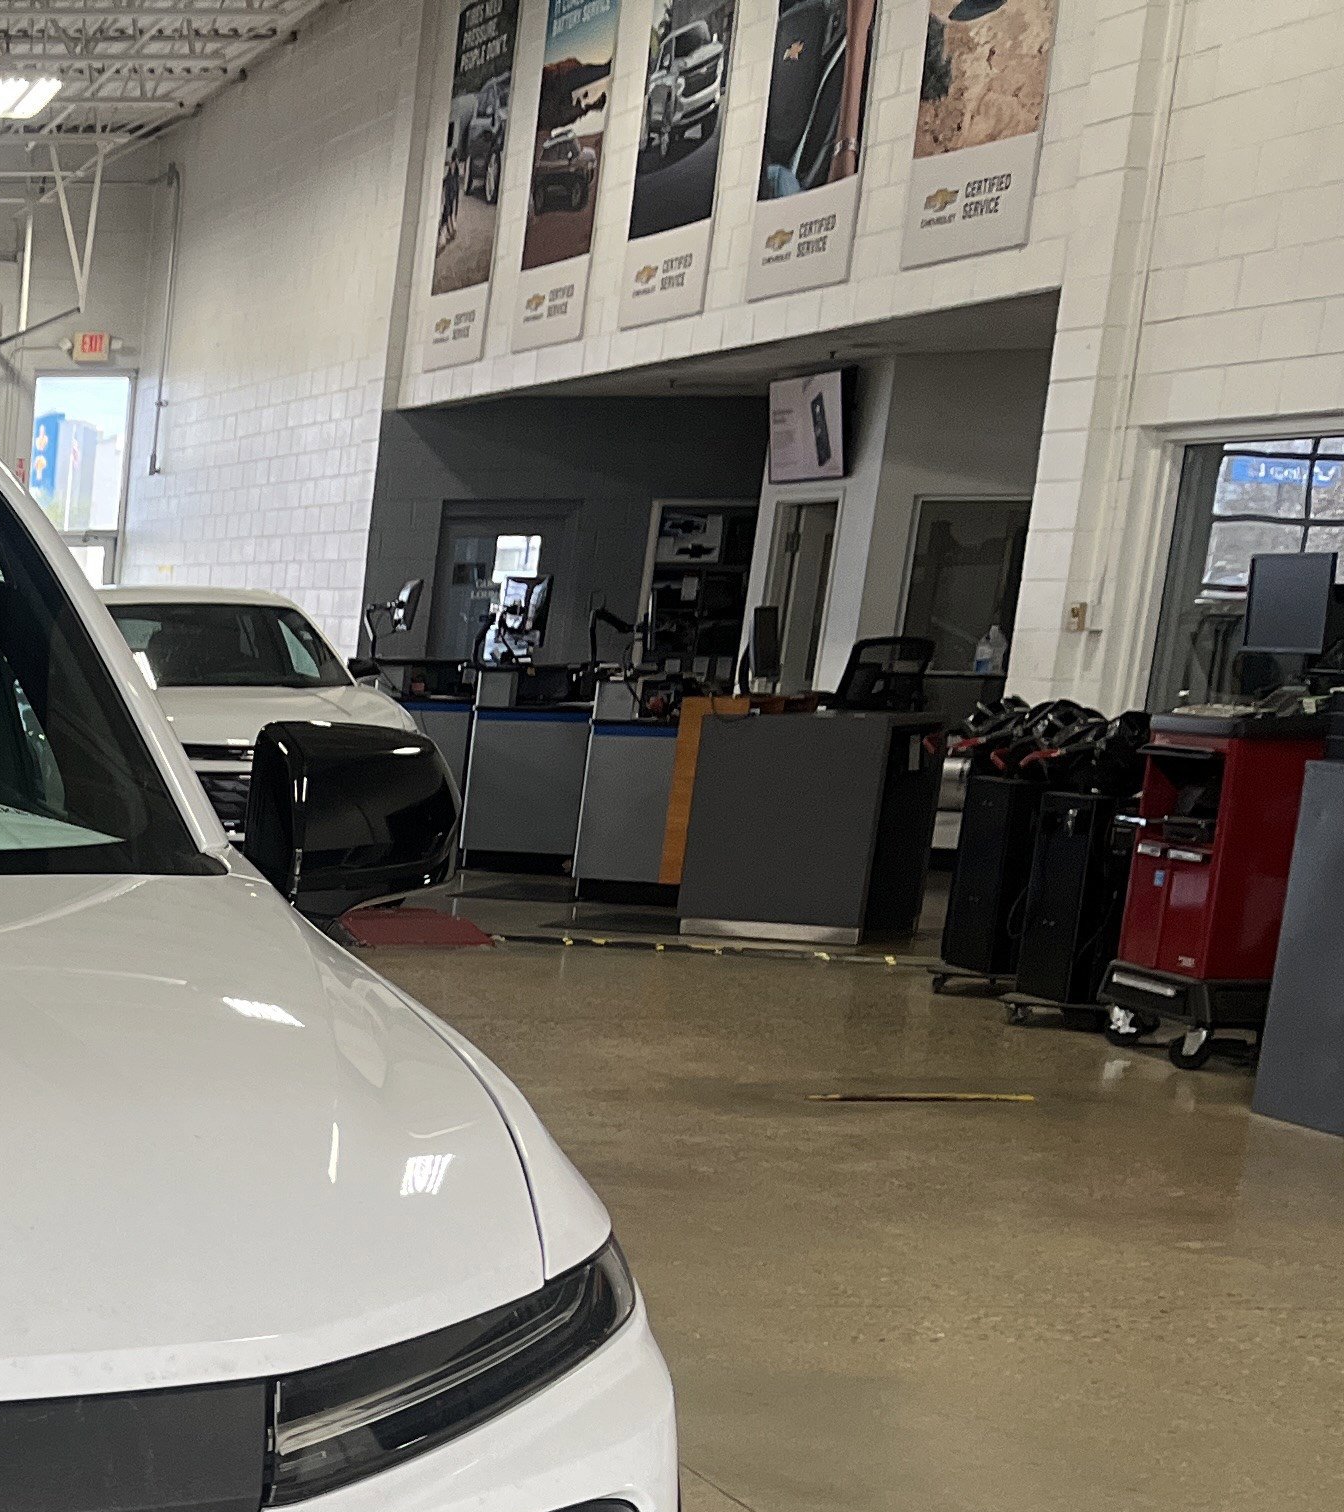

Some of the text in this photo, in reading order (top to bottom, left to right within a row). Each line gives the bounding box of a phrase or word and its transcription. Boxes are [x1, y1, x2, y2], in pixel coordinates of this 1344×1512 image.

[965, 173, 1012, 198] CERTIFIED
[962, 195, 1000, 220] SERVICE
[799, 213, 837, 239] CERTIFIED
[796, 235, 828, 258] SERVICE
[81, 333, 104, 353] EXIT
